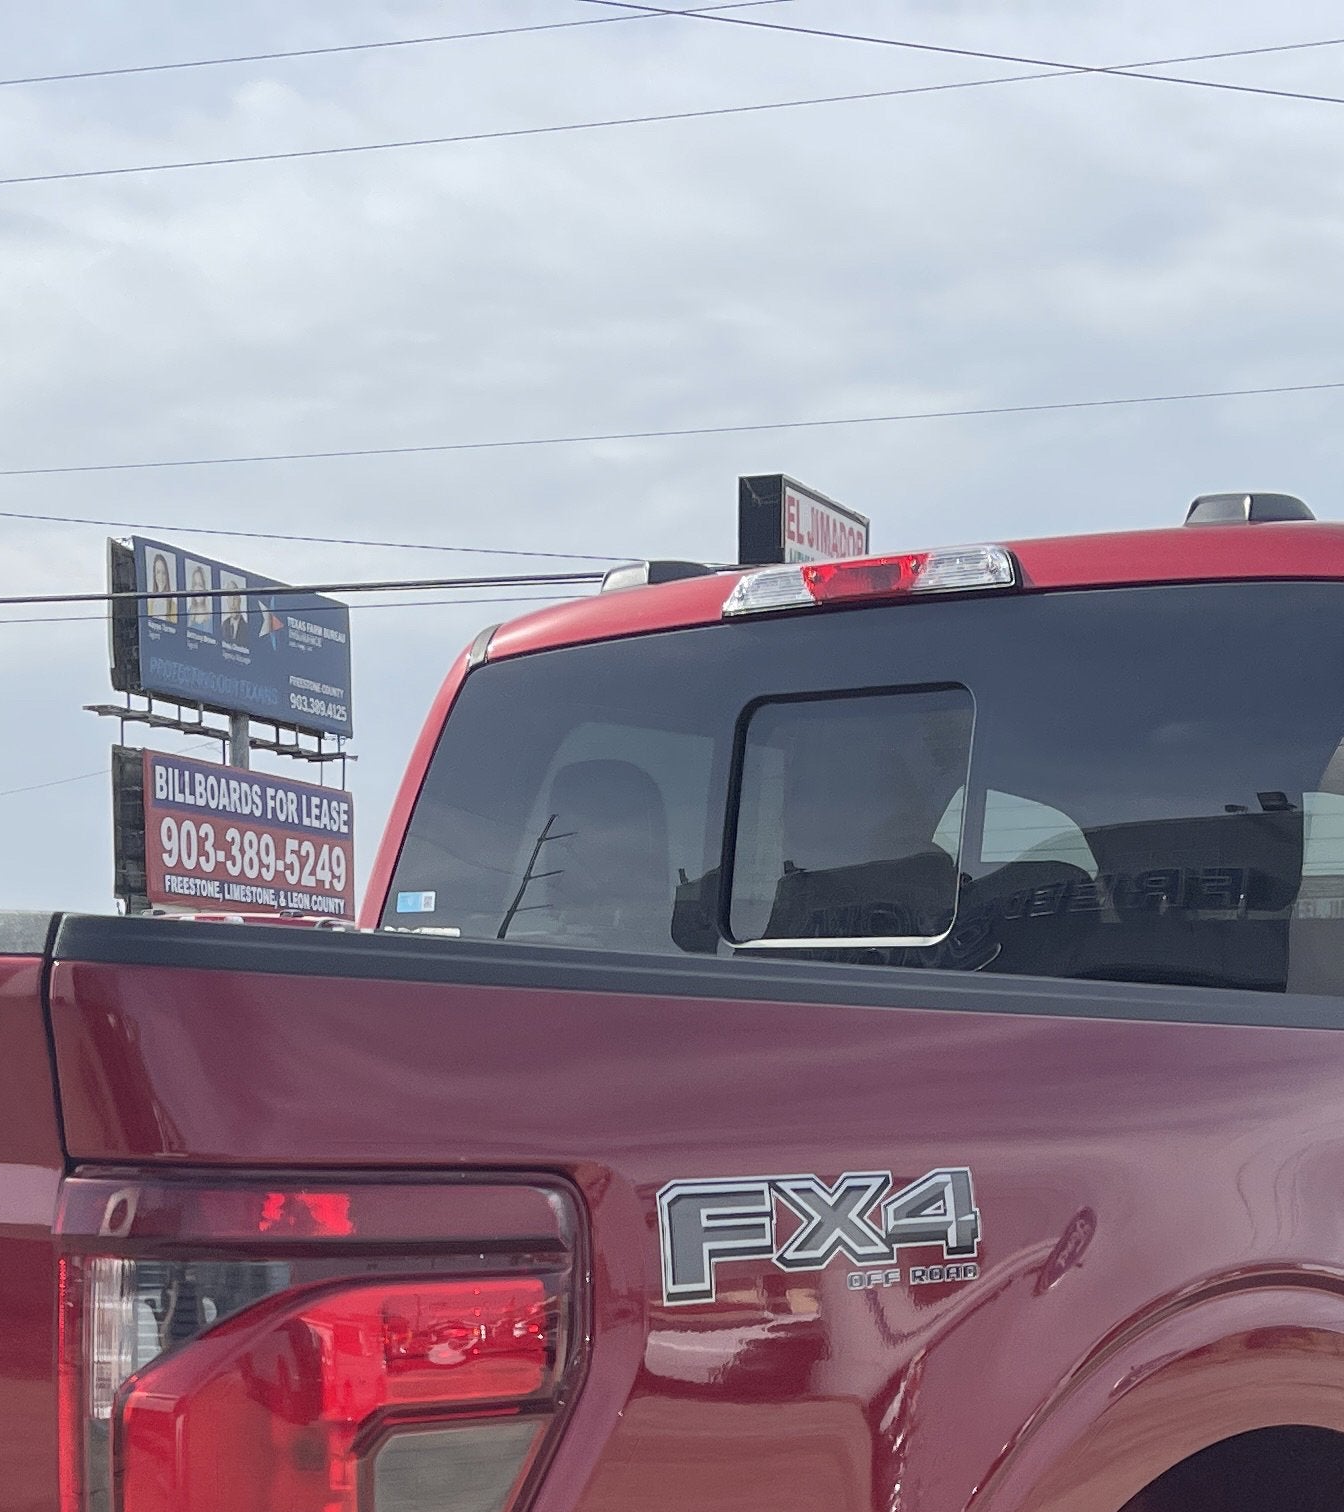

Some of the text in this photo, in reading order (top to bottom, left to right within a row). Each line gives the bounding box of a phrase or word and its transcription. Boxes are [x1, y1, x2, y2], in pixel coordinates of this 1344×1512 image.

[787, 495, 804, 545] EL
[155, 765, 349, 834] BILLBOARDS FOR LEASE
[160, 816, 346, 891] 903-389-5249
[165, 874, 223, 902] FREESTONE,
[224, 883, 278, 909] LIMESTONE,
[287, 891, 310, 910] LEON
[312, 896, 346, 914] COUNTY
[656, 1166, 981, 1306] FX4
[847, 1262, 980, 1291] OFF ROAD
